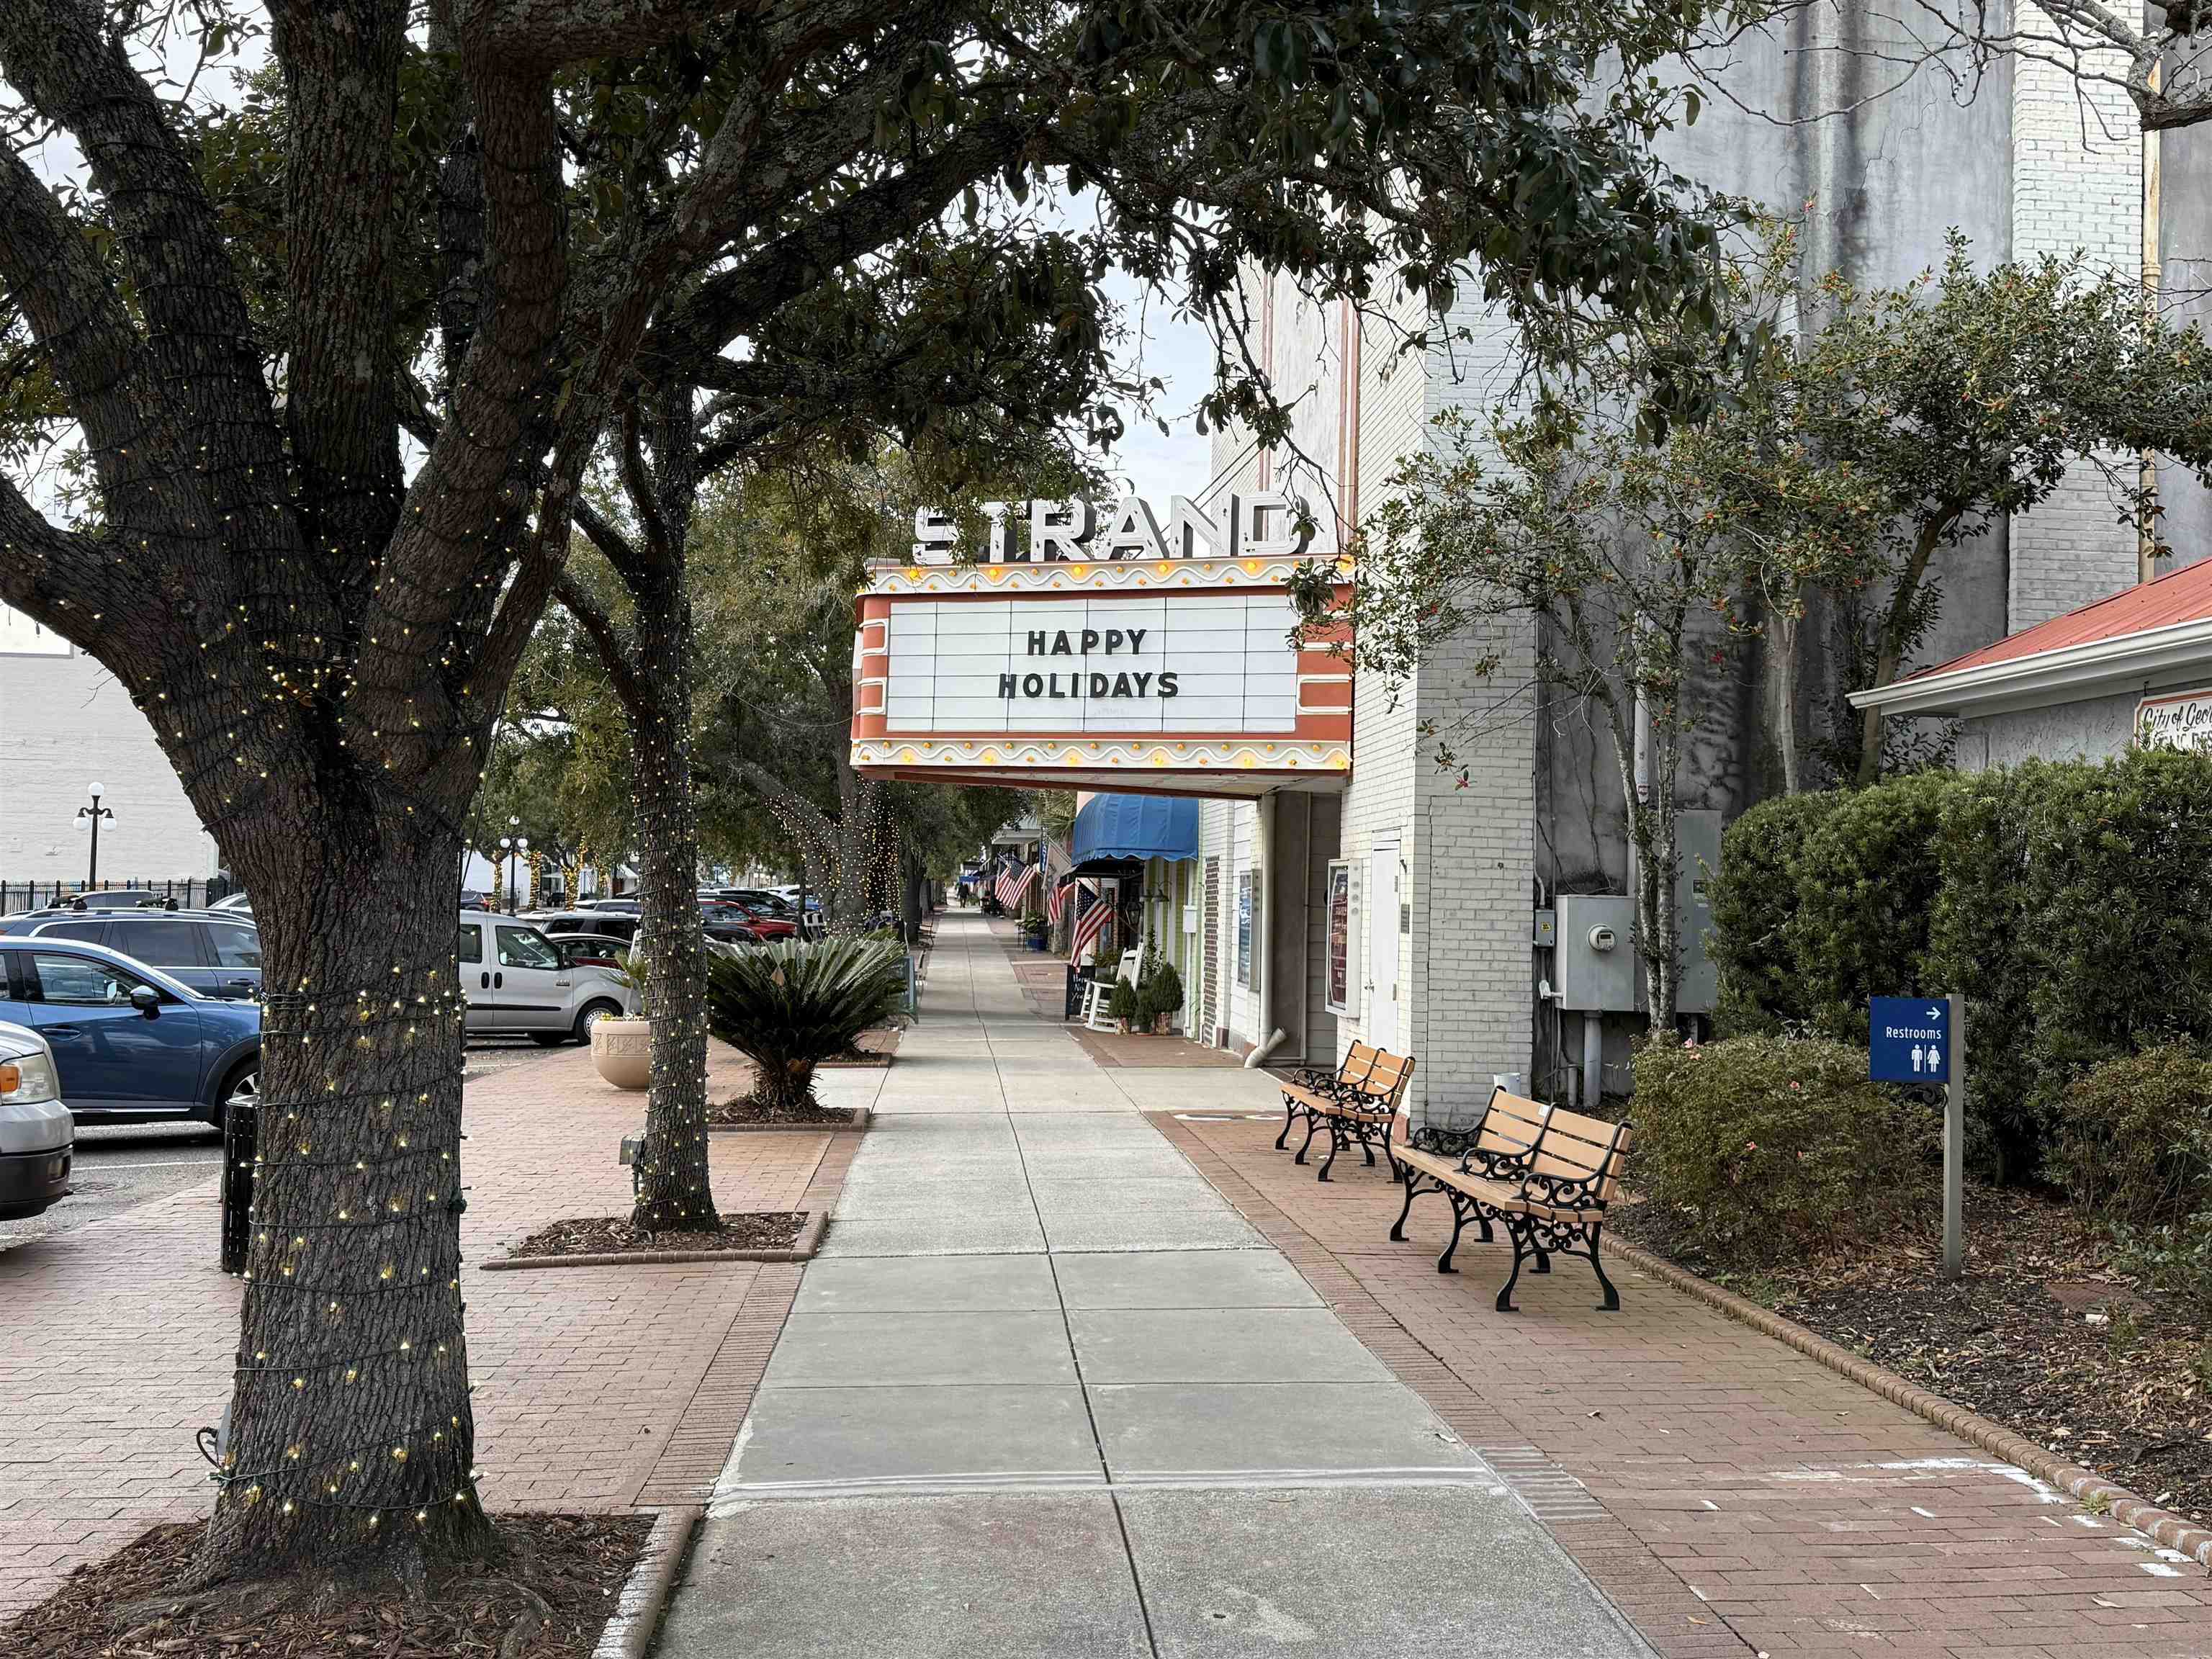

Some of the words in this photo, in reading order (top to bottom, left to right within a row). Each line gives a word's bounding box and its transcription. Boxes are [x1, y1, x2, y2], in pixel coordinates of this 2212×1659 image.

[912, 492, 1310, 565] STRAND
[1028, 629, 1146, 656] HAPPY
[998, 673, 1179, 699] HOLIDAYS
[2144, 708, 2170, 729] City
[2172, 706, 2183, 731] of
[1886, 1026, 1941, 1039] Restrooms
